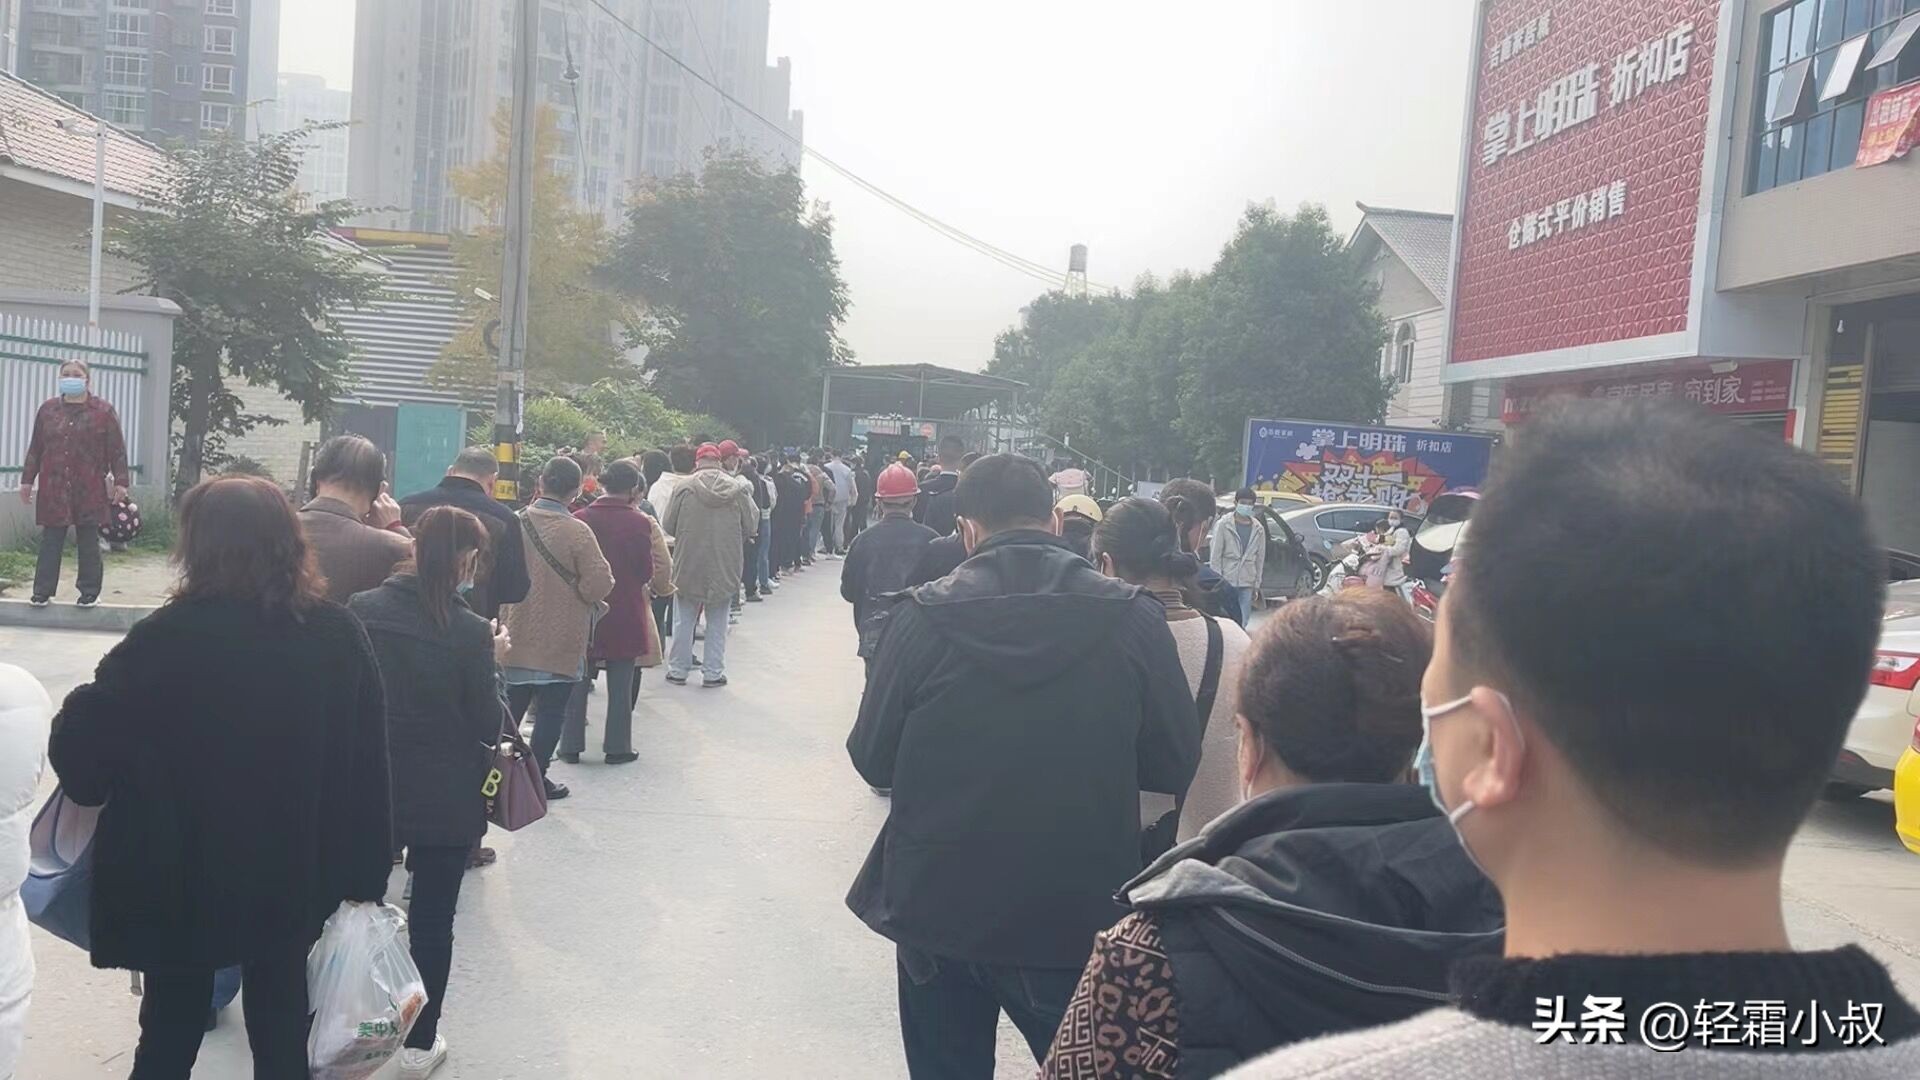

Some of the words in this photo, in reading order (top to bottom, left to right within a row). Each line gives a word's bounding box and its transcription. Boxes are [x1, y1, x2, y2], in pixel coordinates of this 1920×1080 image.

[1482, 63, 1600, 167] 掌上明珠
[1609, 20, 1696, 108] 折扣店
[1508, 179, 1627, 251] 仓储式平价销售
[1311, 428, 1407, 453] 掌上明珠
[1416, 439, 1454, 454] 折扣店
[1320, 462, 1404, 487] 双十一
